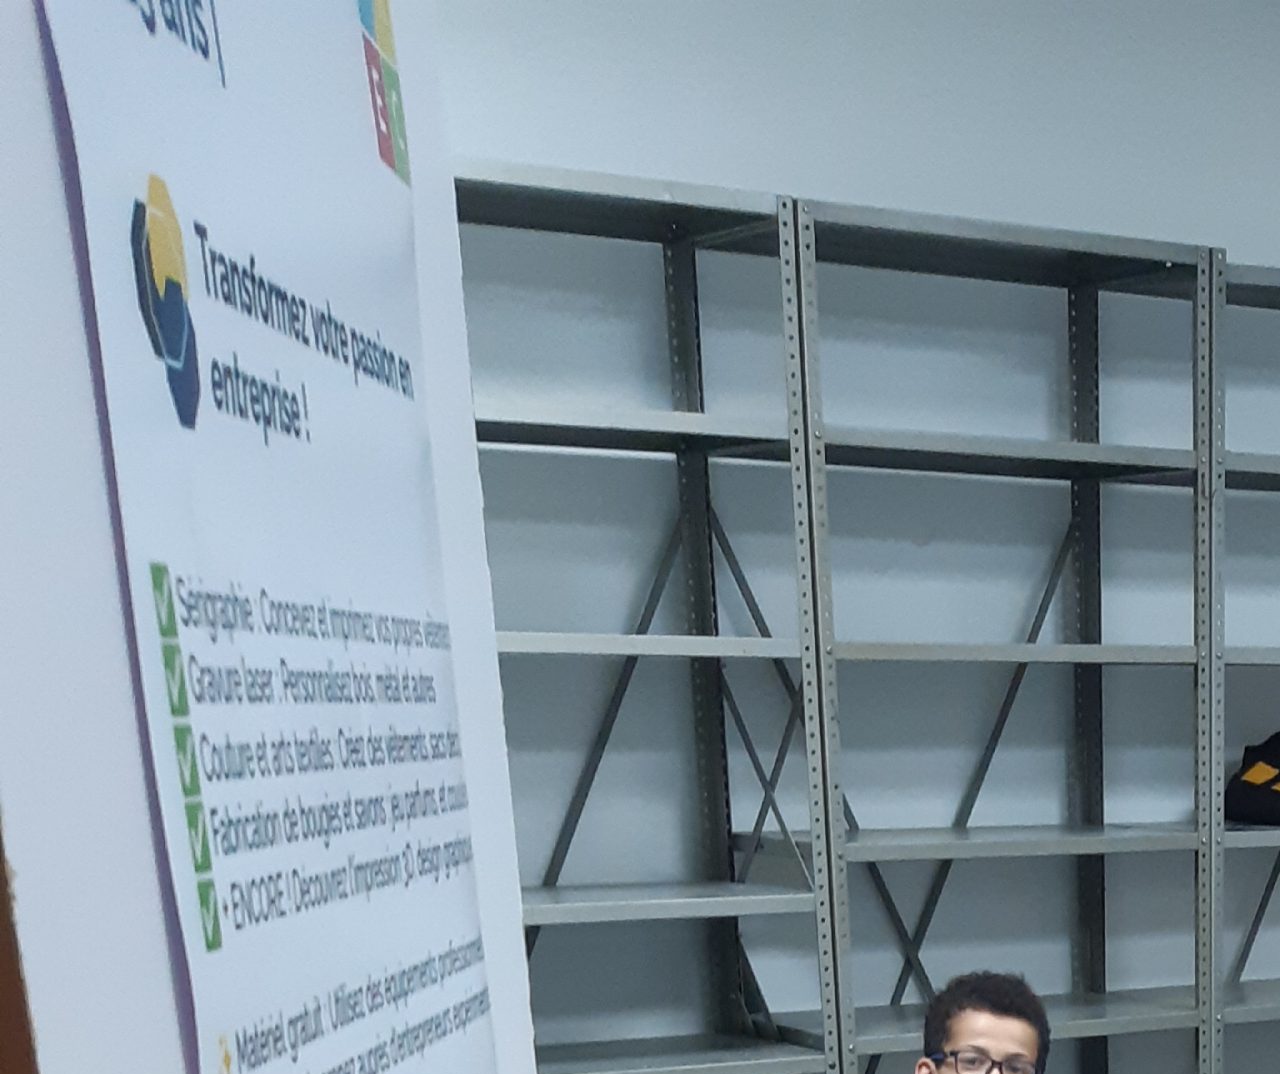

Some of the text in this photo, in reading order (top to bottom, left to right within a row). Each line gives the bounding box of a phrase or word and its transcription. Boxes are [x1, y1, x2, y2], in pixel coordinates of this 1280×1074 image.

[193, 219, 414, 402] Transformez votre passion en
[188, 654, 242, 704] Gravure
[199, 731, 256, 782] Couture
[255, 732, 272, 777] et
[366, 726, 386, 767] des
[210, 800, 281, 856] Fabrication
[283, 797, 299, 844] de
[298, 792, 343, 849] bougies
[343, 791, 355, 832] et
[230, 871, 287, 930] ENCORE
[365, 973, 385, 1014] des
